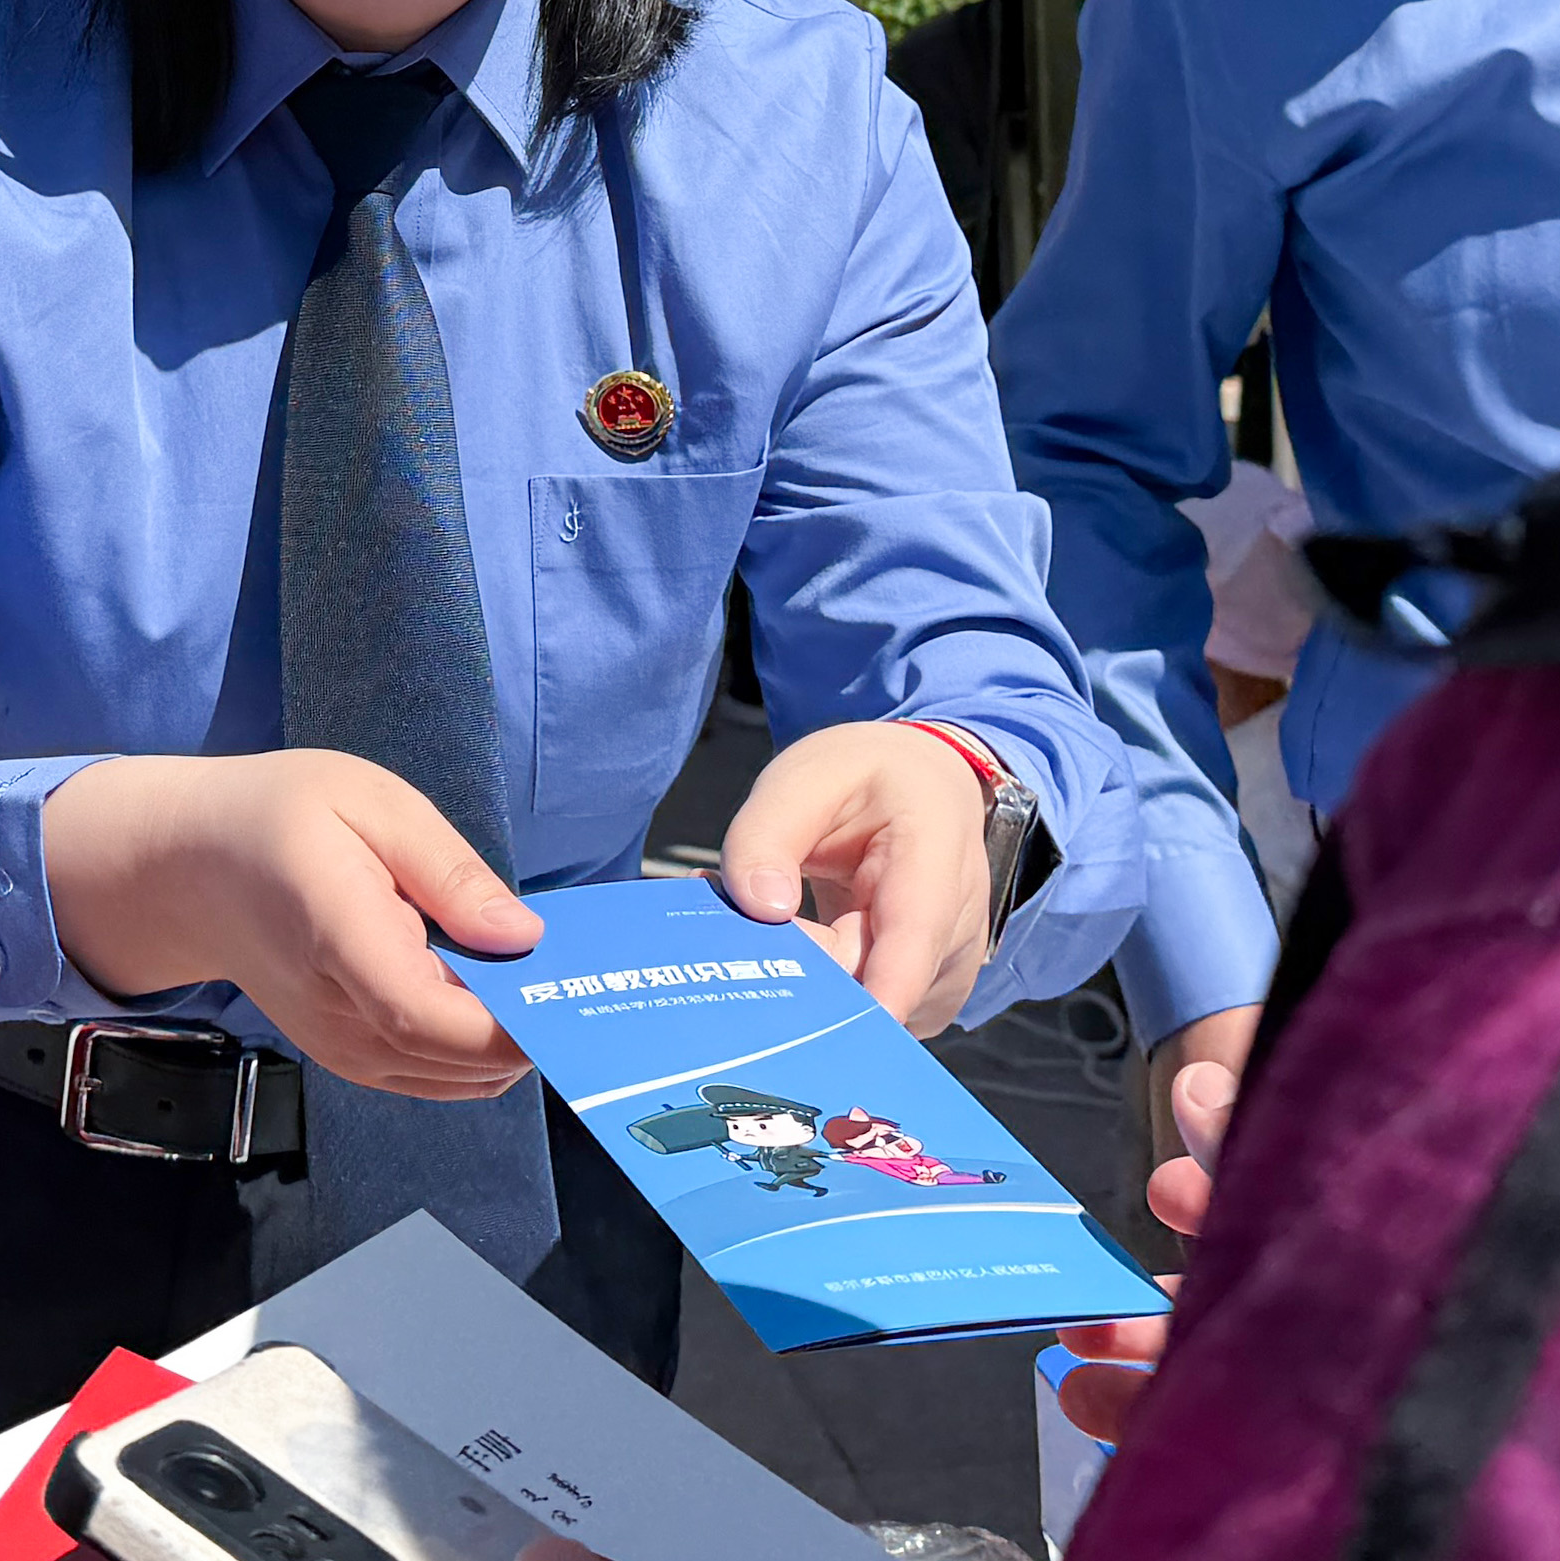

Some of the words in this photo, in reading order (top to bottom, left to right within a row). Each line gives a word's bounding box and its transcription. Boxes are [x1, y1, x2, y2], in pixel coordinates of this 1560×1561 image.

[520, 958, 807, 1004] 反邪教知识宣传
